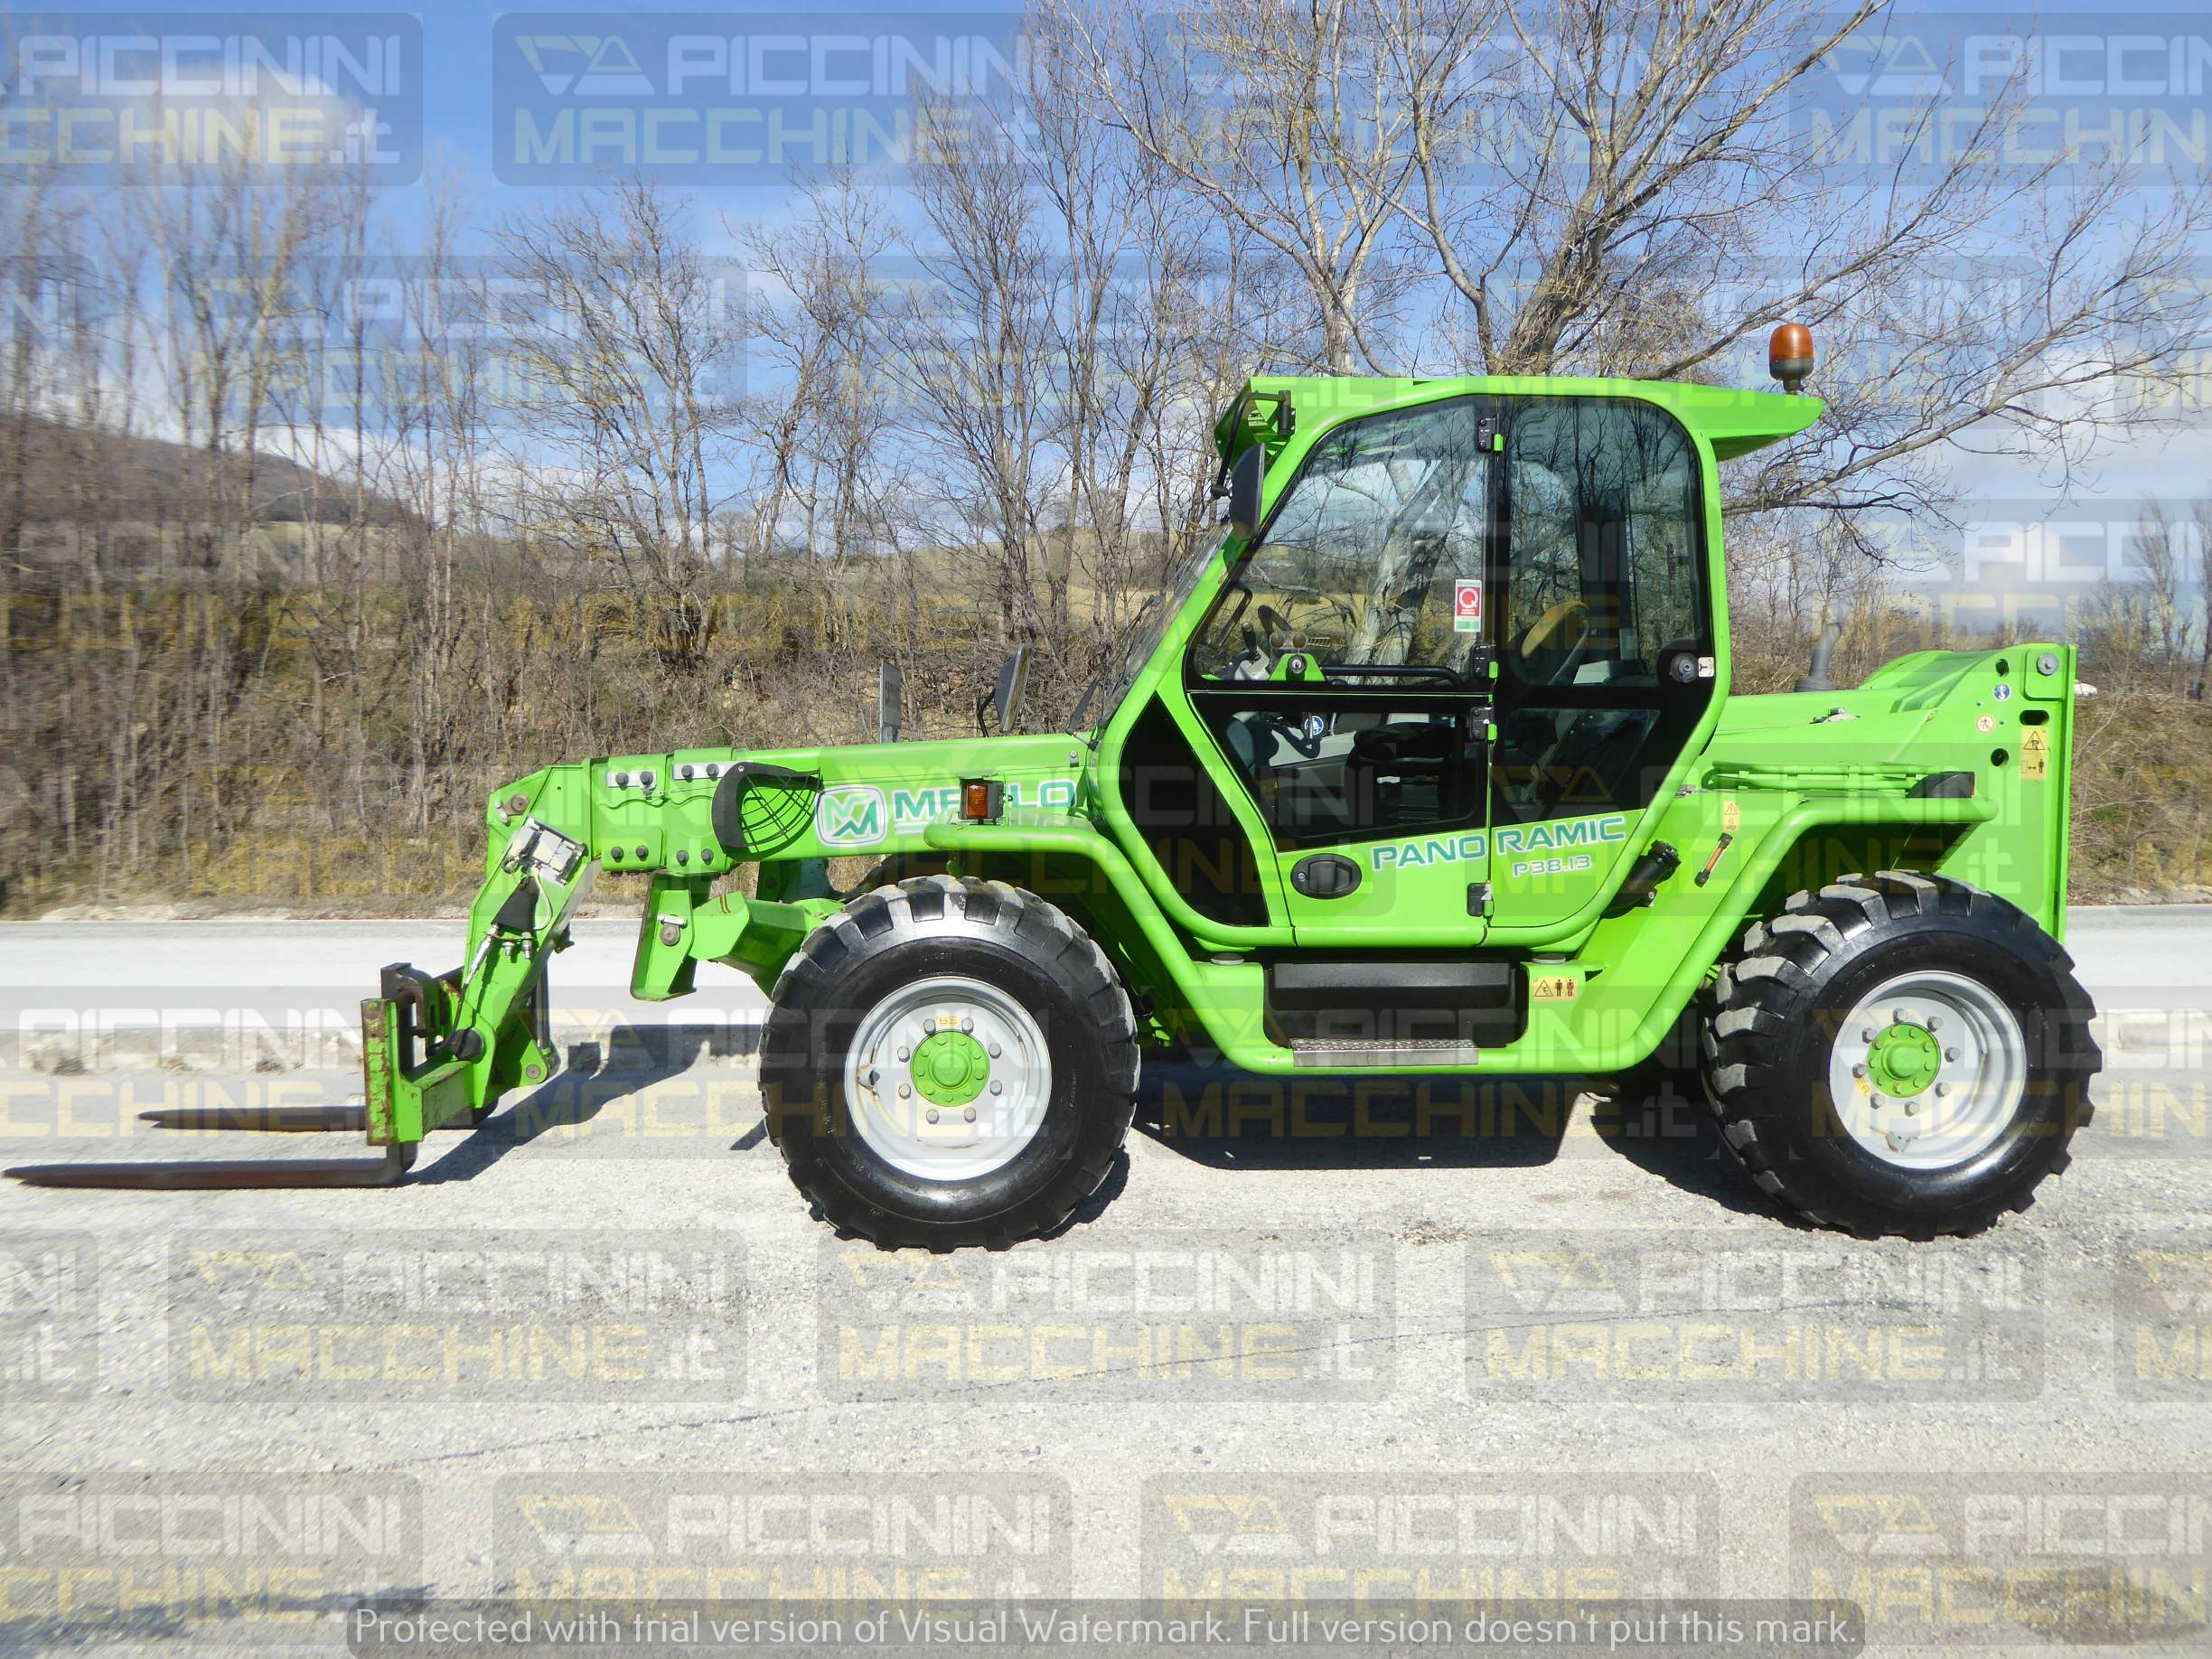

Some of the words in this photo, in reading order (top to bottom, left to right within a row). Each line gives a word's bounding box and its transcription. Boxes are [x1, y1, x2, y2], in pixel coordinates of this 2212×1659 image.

[895, 780, 1077, 820] MLO
[1372, 816, 1626, 871] PANORAMIC
[1513, 855, 1591, 878] P38.13
